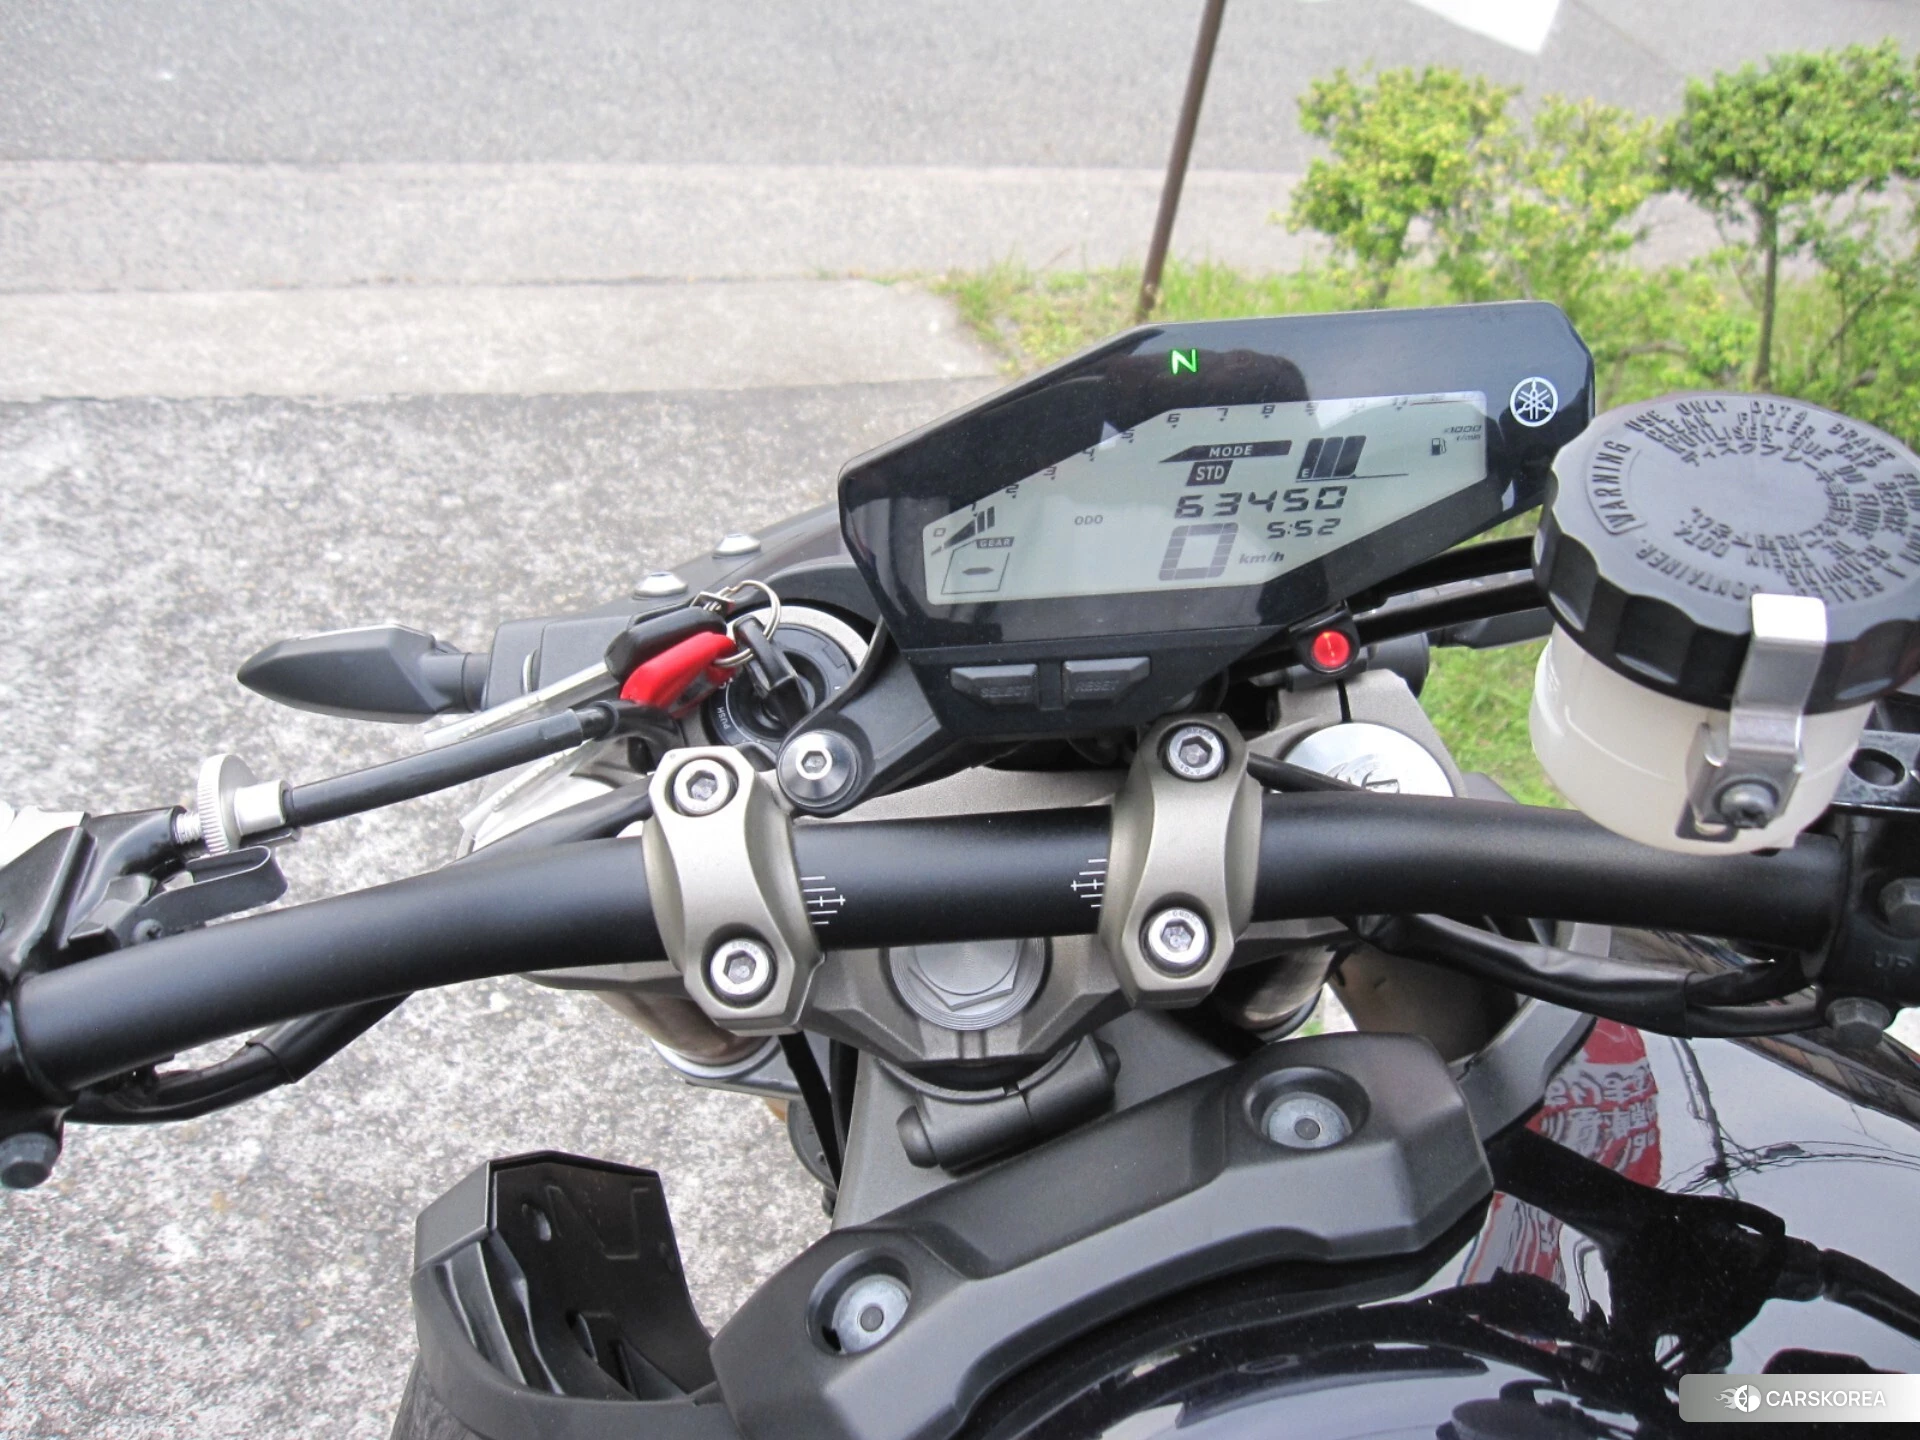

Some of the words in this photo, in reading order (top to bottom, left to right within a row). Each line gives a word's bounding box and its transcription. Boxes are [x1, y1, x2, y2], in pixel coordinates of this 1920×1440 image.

[1171, 348, 1197, 375] N
[1165, 413, 1182, 423] 6
[1216, 407, 1230, 418] 7
[1260, 404, 1275, 415] 8
[1624, 409, 1666, 432] USE
[1675, 399, 1727, 416] ONLY
[1827, 422, 1896, 462] BRAKE
[1645, 414, 1711, 443] CLEAN
[1834, 442, 1878, 468] CAP
[1208, 445, 1254, 458] MODE
[1789, 436, 1833, 461] QUE
[1194, 465, 1225, 481] STD
[1300, 468, 1310, 478] E
[1591, 440, 1636, 529] WARNING
[1174, 485, 1348, 519] 63450
[1073, 514, 1105, 526] ODO
[1266, 517, 1342, 540] 5:52
[979, 538, 1011, 548] GEAR
[1158, 521, 1239, 581] 0
[1239, 551, 1285, 565] km/h
[980, 685, 1032, 698] SELECT
[1074, 679, 1120, 693] RESET
[716, 706, 731, 731] PUSH
